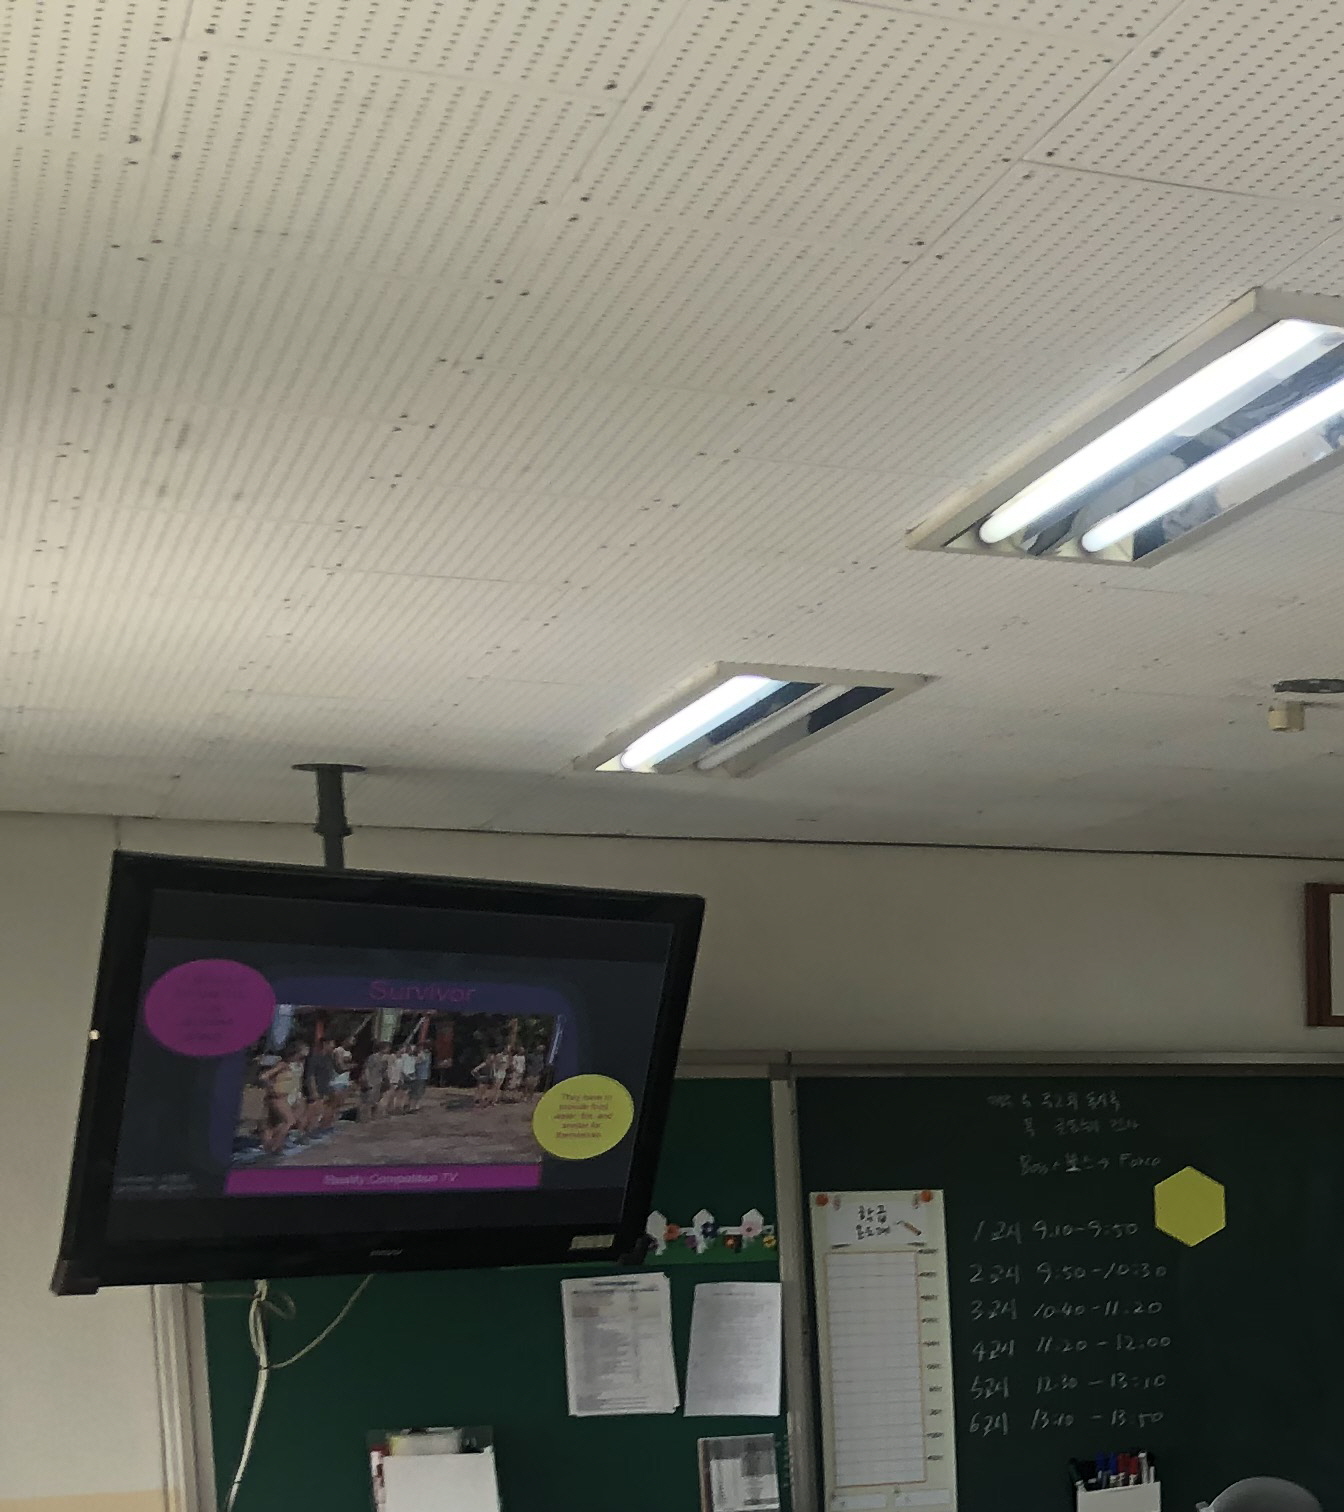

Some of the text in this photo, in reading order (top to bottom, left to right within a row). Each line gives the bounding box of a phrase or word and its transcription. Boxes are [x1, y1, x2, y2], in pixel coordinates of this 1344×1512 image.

[369, 980, 476, 1002] Survivor
[322, 1171, 459, 1186] Reality Competition TV
